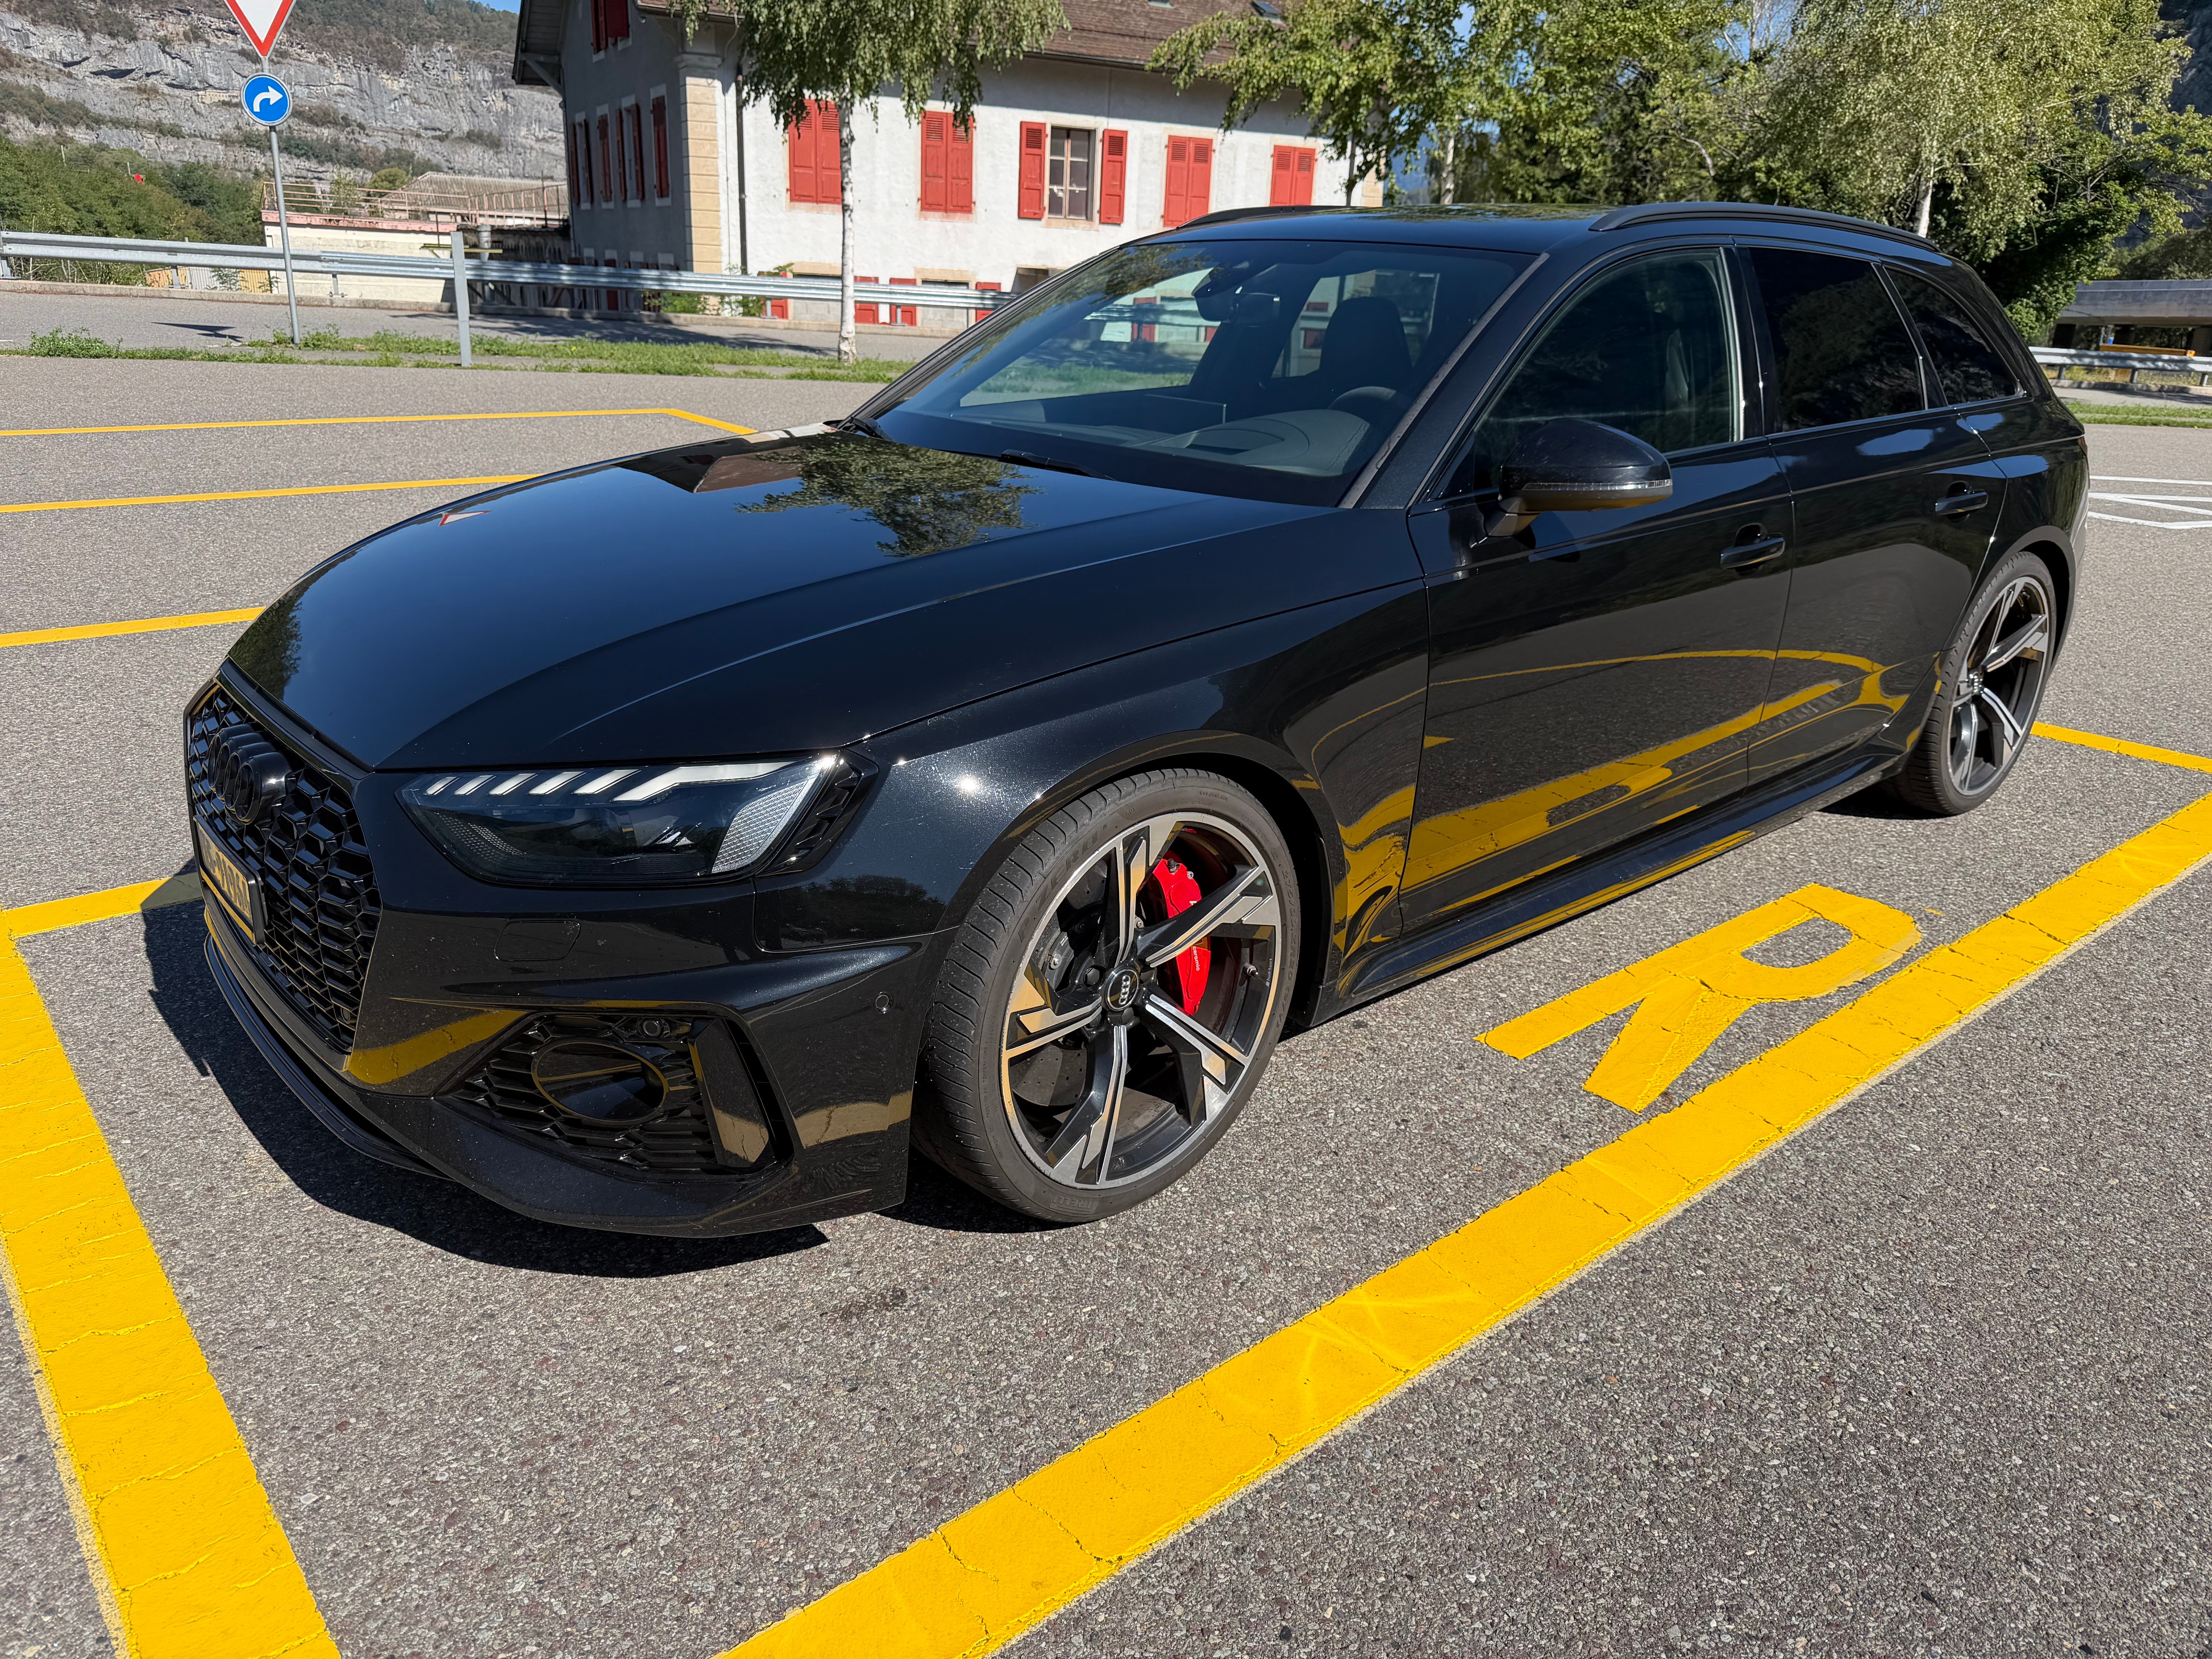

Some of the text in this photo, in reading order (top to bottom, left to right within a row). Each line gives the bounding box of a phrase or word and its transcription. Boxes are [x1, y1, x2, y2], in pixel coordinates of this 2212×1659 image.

[1036, 831, 1098, 911] ZERO
[1474, 883, 1922, 1115] R
[1049, 1195, 1099, 1215] PIRELLI
